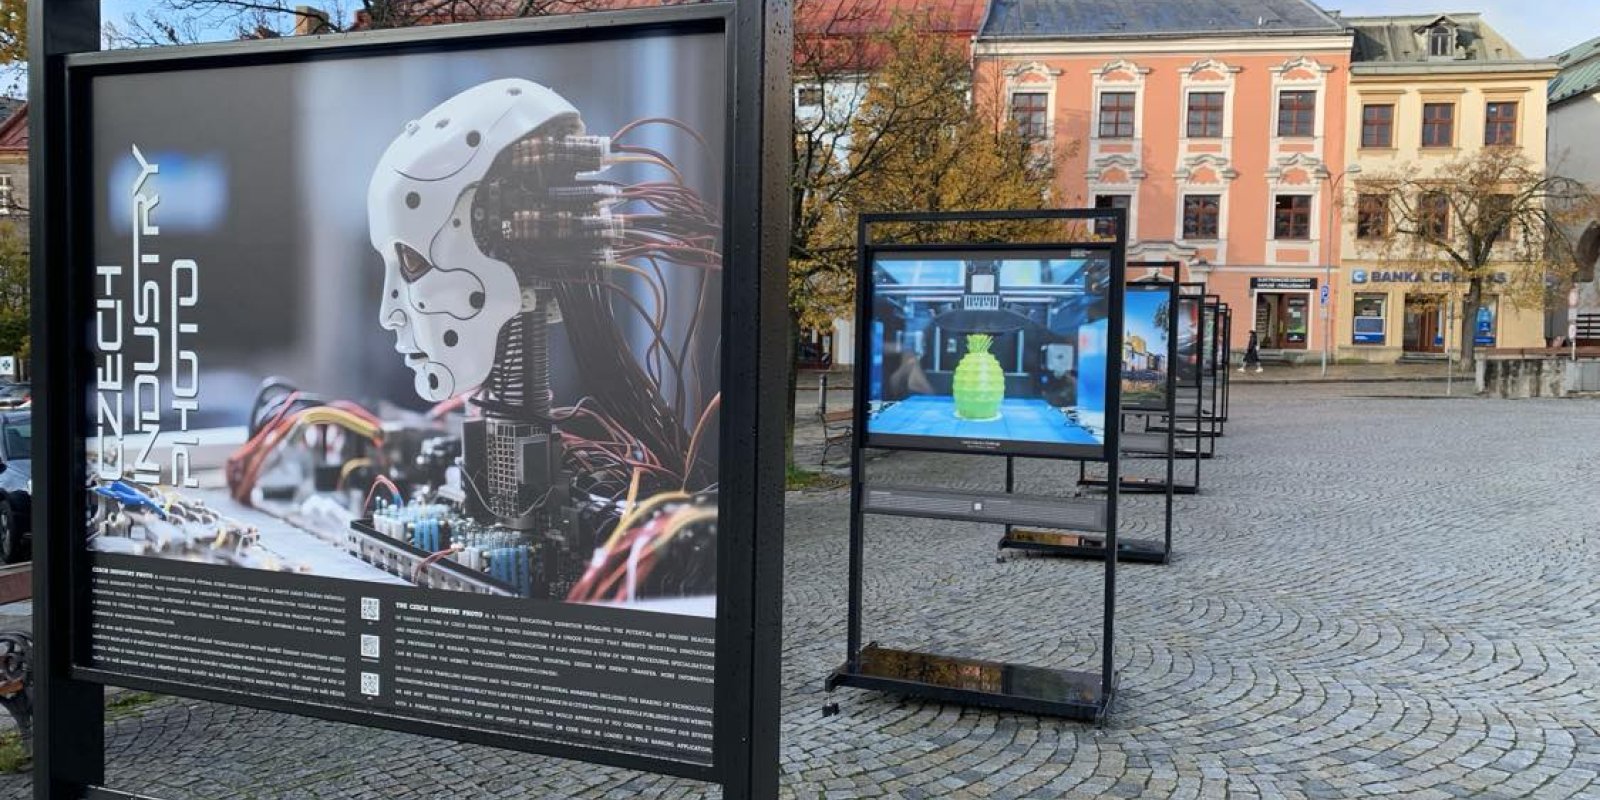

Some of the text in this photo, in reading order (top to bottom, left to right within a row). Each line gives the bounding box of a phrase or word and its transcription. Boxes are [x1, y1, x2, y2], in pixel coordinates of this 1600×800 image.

[97, 266, 123, 481] CZECH
[133, 143, 160, 485] INDUSTRY
[172, 259, 199, 488] PHOTO
[1371, 271, 1424, 283] BANKA
